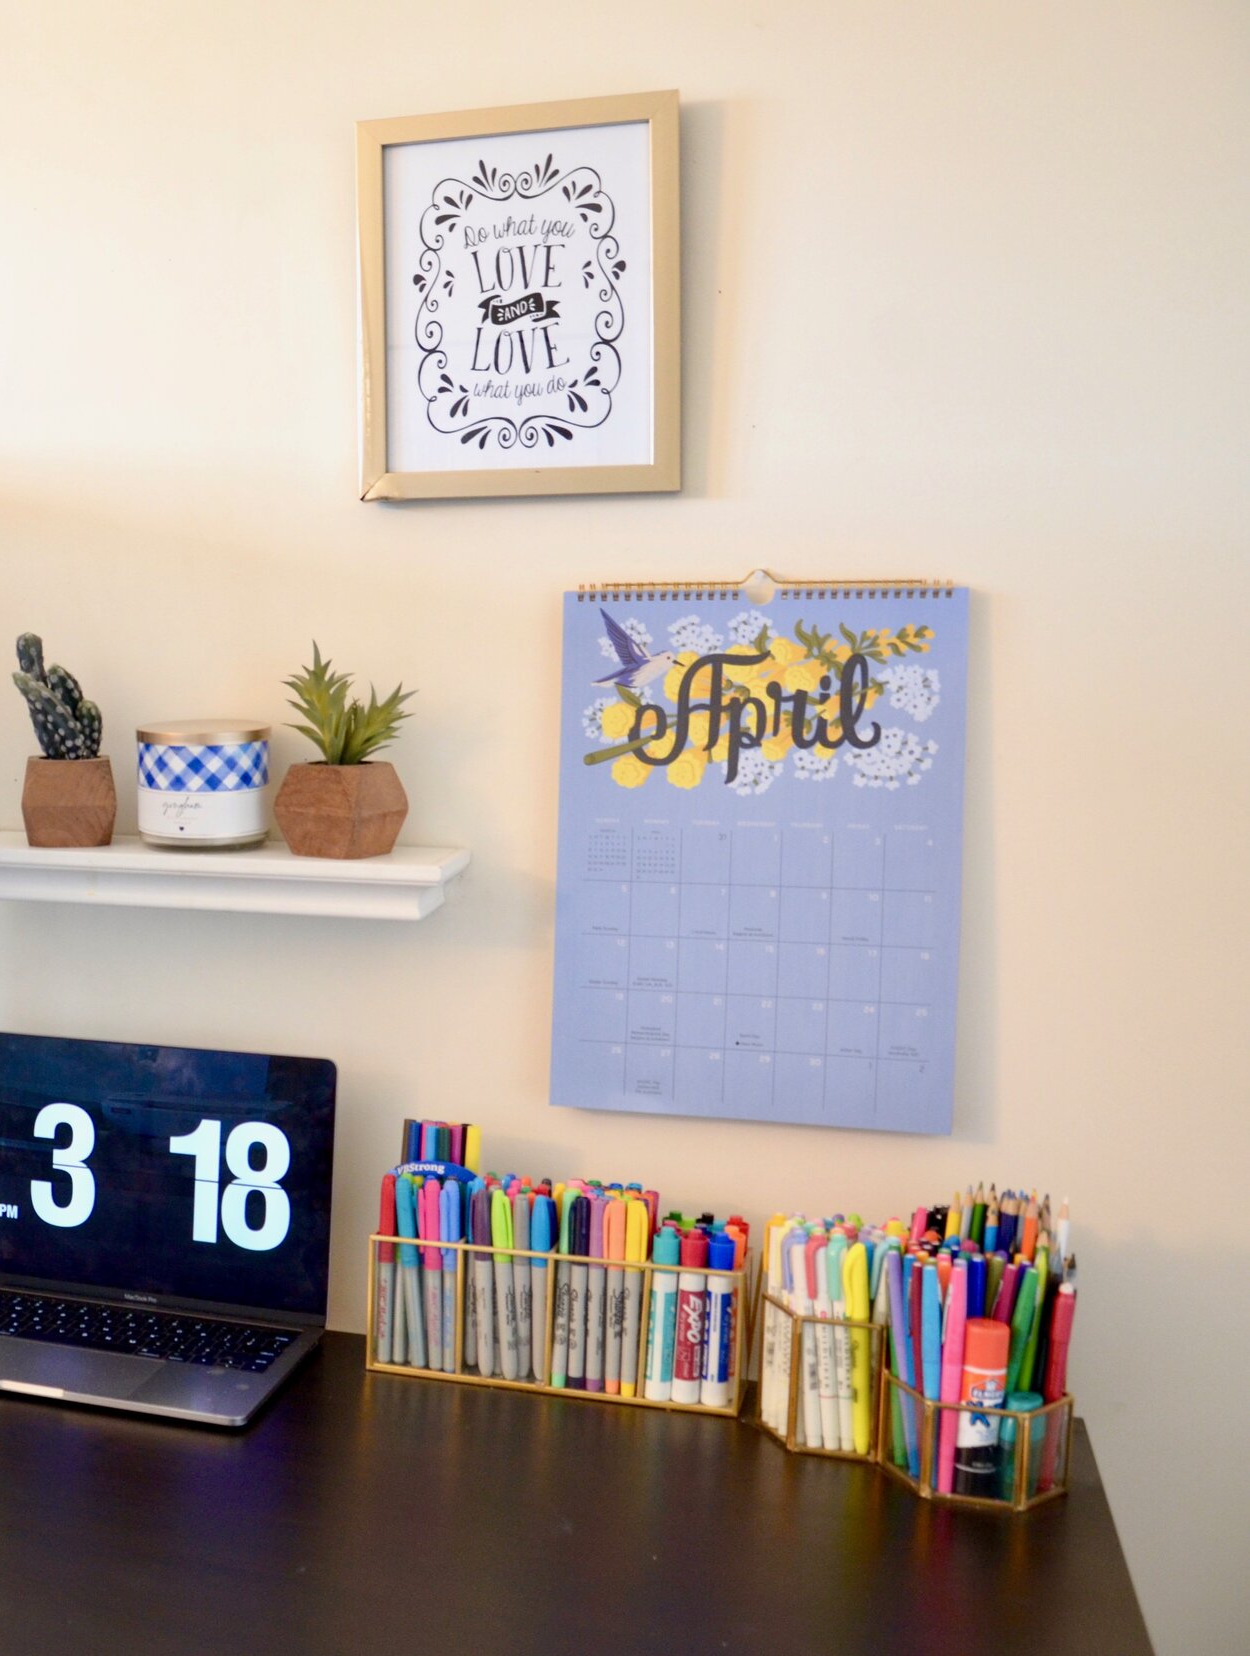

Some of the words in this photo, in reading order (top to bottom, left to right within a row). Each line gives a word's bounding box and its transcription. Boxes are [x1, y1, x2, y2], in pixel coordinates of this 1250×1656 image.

[464, 225, 489, 249] Do
[493, 214, 538, 239] what
[541, 218, 575, 244] you
[471, 243, 566, 294] LOVE
[504, 300, 528, 321] AND
[470, 321, 570, 376] LOVE
[473, 379, 511, 399] what
[514, 382, 544, 406] you
[546, 374, 566, 394] do
[627, 650, 882, 785] April
[30, 1102, 96, 1228] 3
[168, 1118, 291, 1251] 18
[682, 1294, 703, 1344] EXPO
